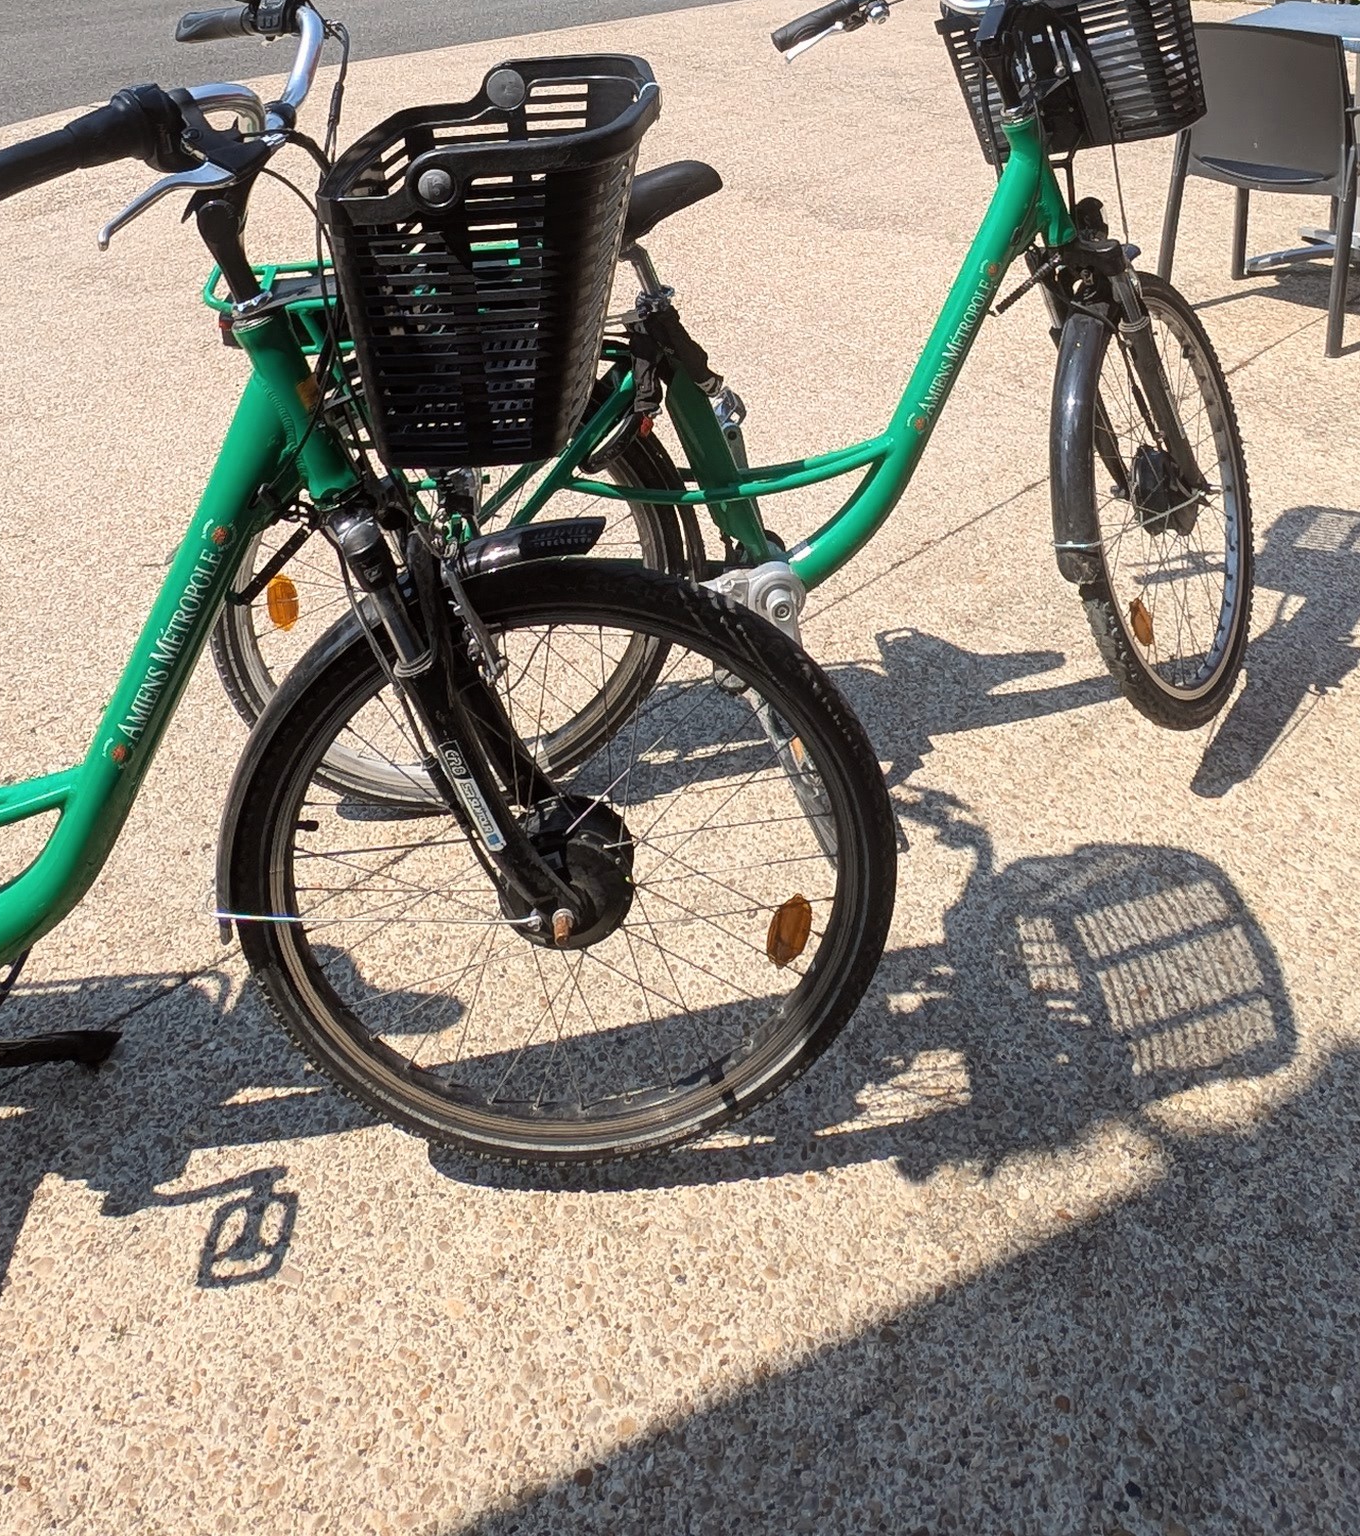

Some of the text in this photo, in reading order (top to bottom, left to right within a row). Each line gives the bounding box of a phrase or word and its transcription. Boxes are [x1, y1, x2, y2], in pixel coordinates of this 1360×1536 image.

[918, 361, 953, 416] AMIENS
[942, 278, 991, 363] MÉTROPOLE
[117, 665, 168, 740] AMIENS
[149, 548, 222, 667] MÉTROPOLE
[469, 797, 495, 834] SUNTOUR
